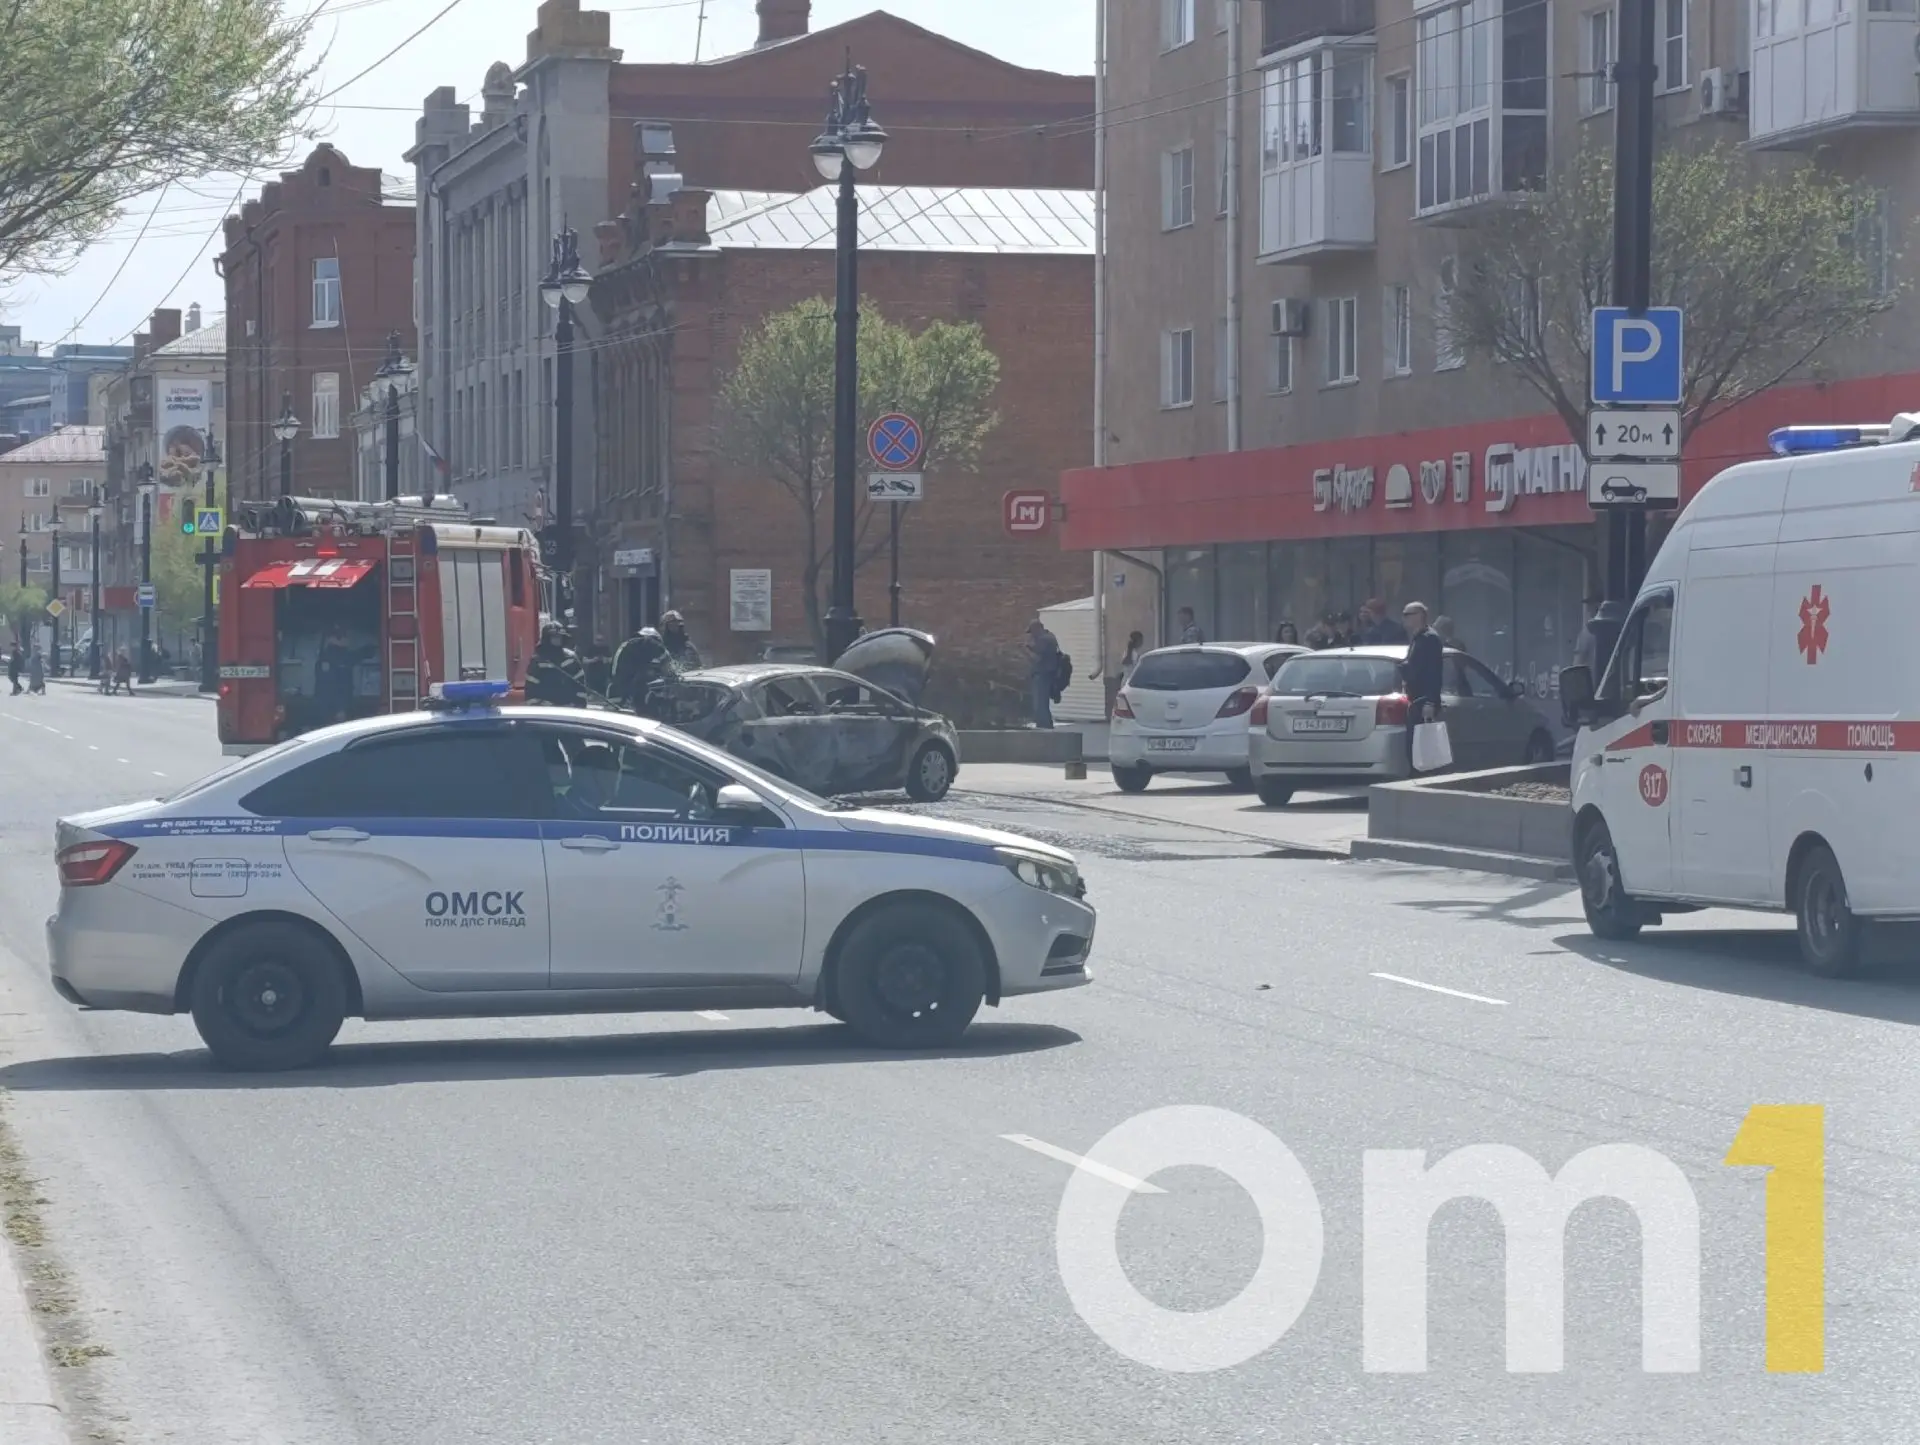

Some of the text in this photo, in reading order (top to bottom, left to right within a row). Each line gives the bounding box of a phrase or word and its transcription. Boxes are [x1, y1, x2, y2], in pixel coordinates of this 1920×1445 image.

[1612, 319, 1661, 392] P
[1686, 724, 1895, 749] СКОРАЯ МЕДИЦИНСКАЯ ПОМОЩЬ
[1643, 771, 1663, 799] 317
[621, 824, 730, 844] ПОЛИЦИЯ
[425, 890, 525, 916] ОМСК
[425, 917, 526, 928] ПОЛК ДПС ГИБДД
